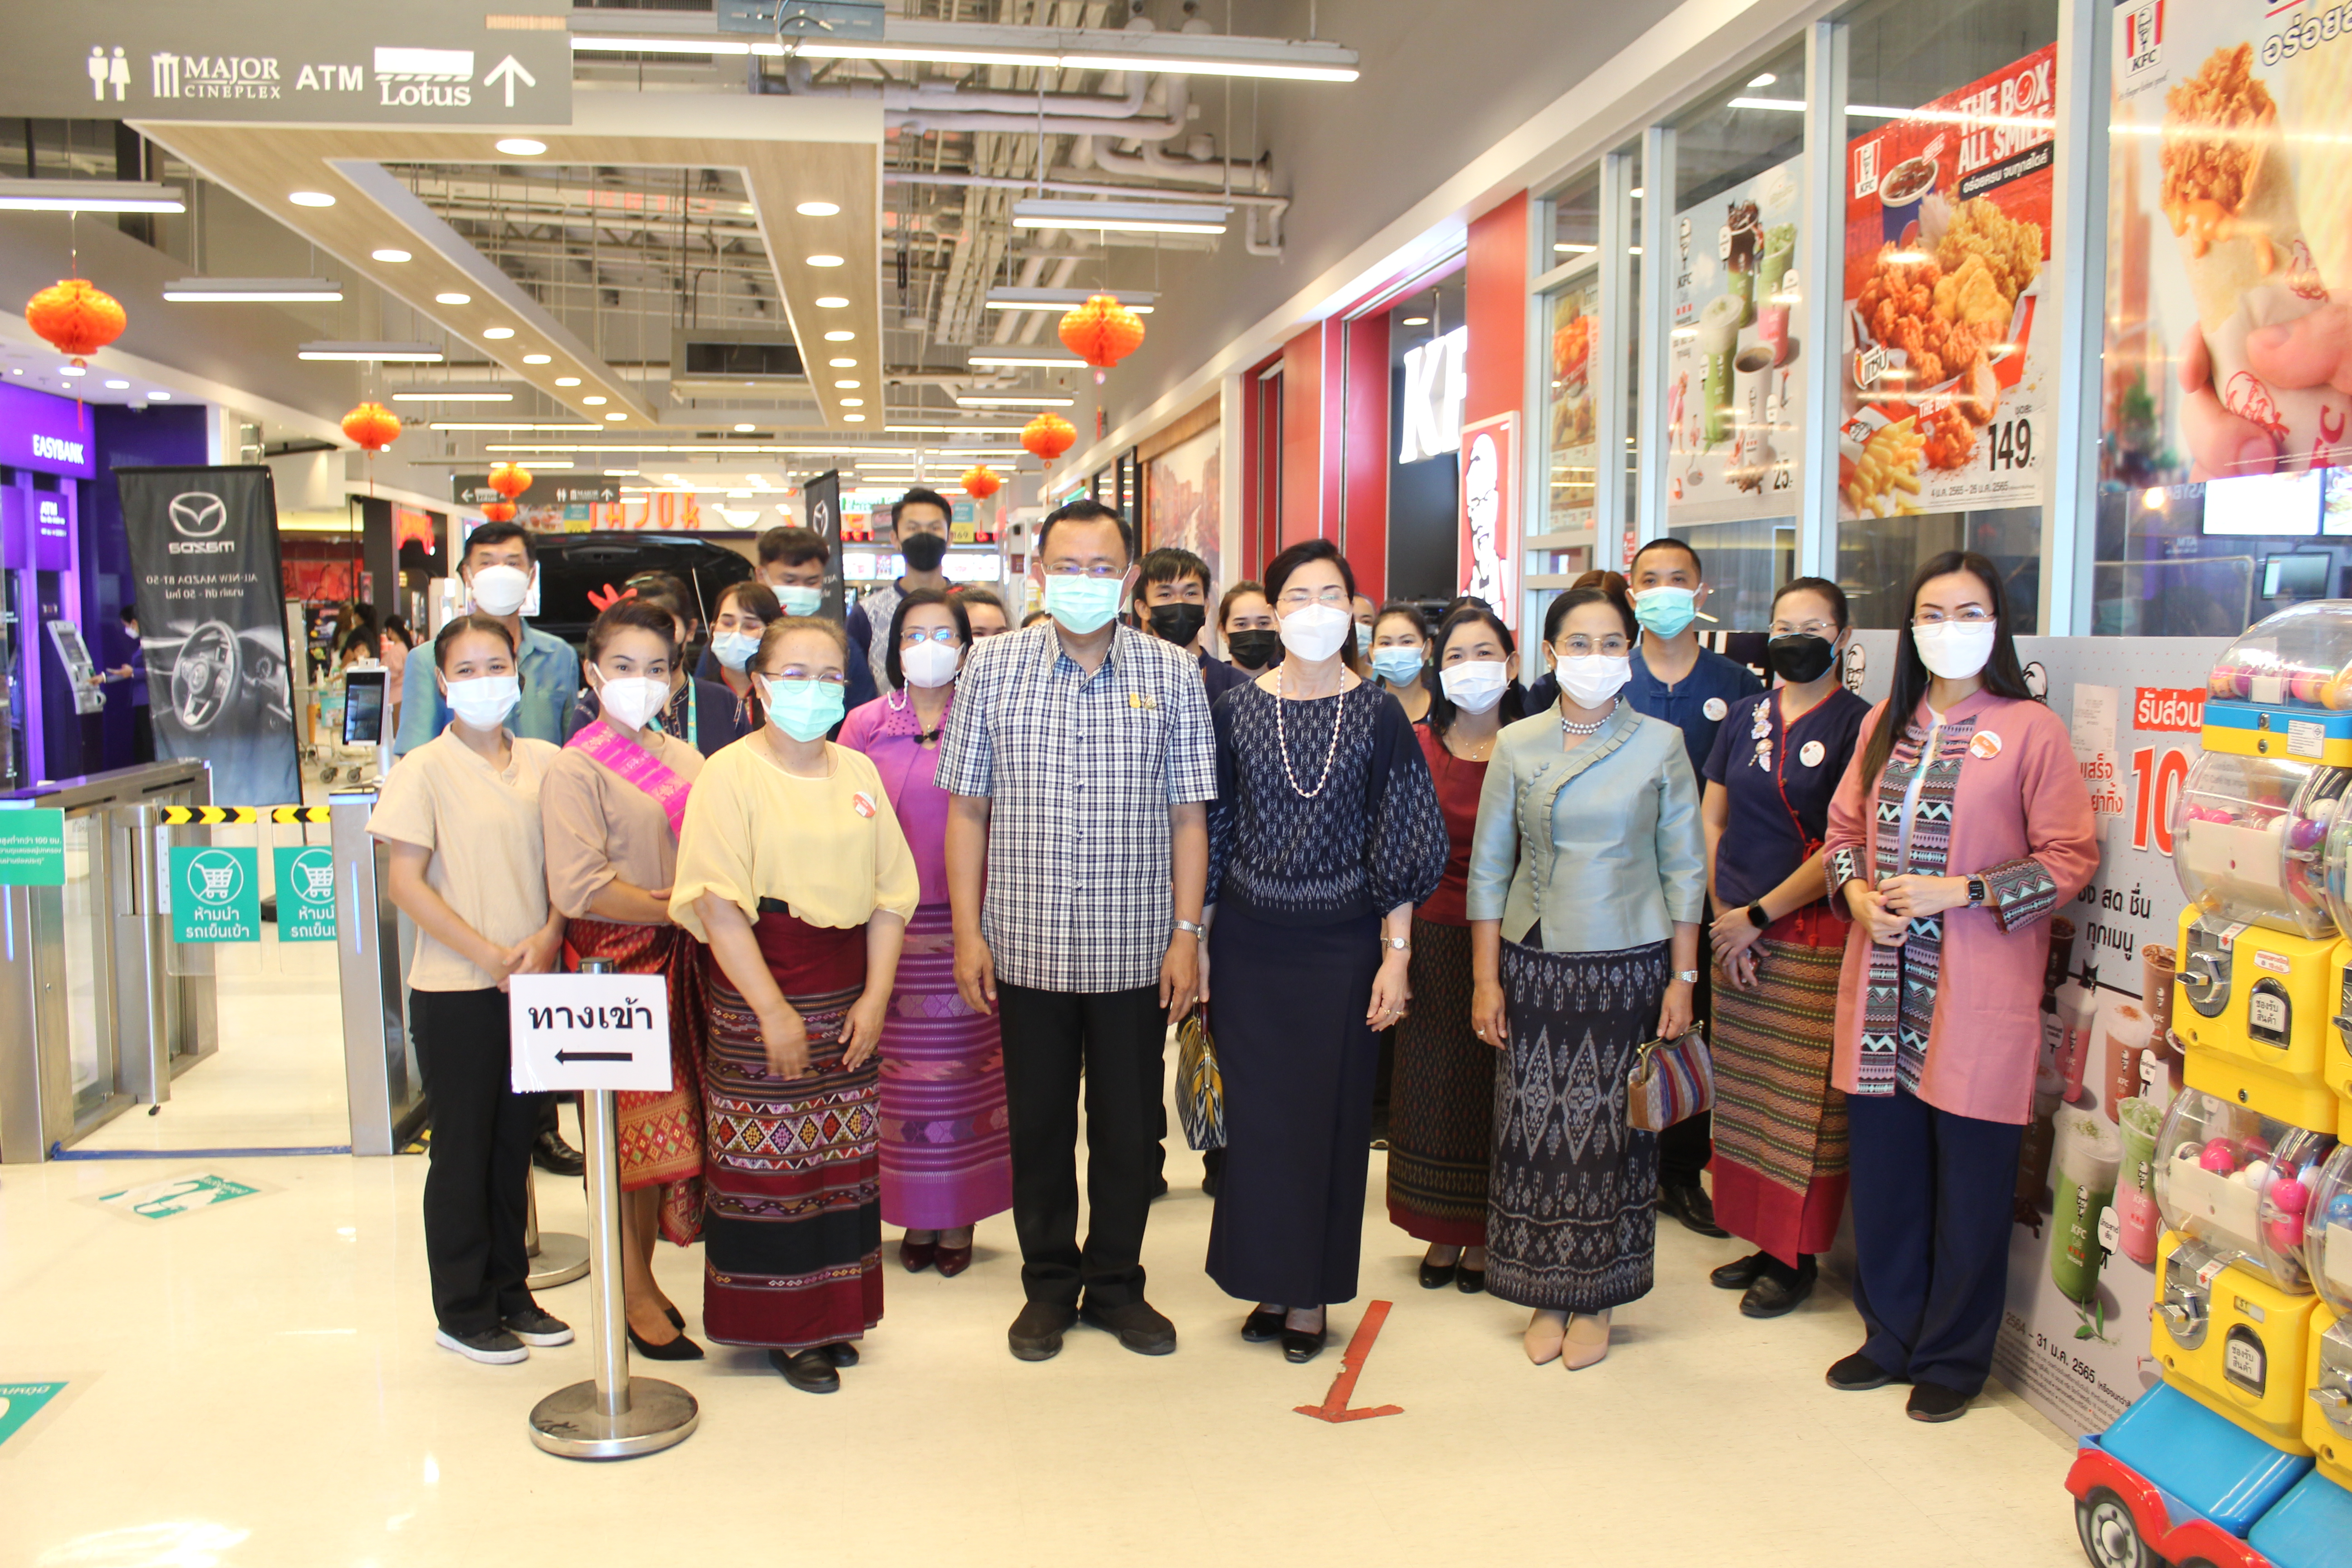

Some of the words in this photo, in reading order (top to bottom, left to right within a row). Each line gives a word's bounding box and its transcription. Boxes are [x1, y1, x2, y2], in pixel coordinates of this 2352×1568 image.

[2132, 49, 2156, 72] KFC
[184, 56, 280, 84] MAJOR
[296, 65, 363, 91] ATM
[380, 81, 472, 106] Lotus
[185, 85, 280, 99] CINEPLEX
[1959, 85, 1998, 137] THE
[2000, 59, 2051, 118] BOX
[1957, 130, 1990, 176] ALL
[1992, 103, 2050, 161] SMILE
[33, 434, 85, 466] EASYBANK
[40, 500, 58, 516] ATM
[2138, 691, 2202, 728] รับส่วน
[2080, 753, 2113, 780] เสร็จ
[2091, 782, 2124, 814] ย่าทิ้ง
[35, 836, 48, 844] 100
[195, 906, 240, 921] ห้ามนำ
[186, 922, 250, 938] รถเข็นเข้า
[291, 921, 336, 937] รถเข็นเ
[2086, 921, 2133, 961] ทุกเมนู
[528, 997, 652, 1029] ทางเข้า
[2256, 997, 2278, 1013] ช่องรับ
[2257, 1009, 2276, 1025] สินค้า
[2133, 1194, 2147, 1207] KFC
[2070, 1224, 2087, 1240] KFC
[2005, 1311, 2027, 1336] 2564
[2036, 1333, 2047, 1350] 31
[2050, 1343, 2069, 1367] ม.ค.
[2072, 1357, 2096, 1383] 2565
[2231, 1343, 2254, 1362] ช่องรับ
[2232, 1356, 2252, 1374] สินค้า
